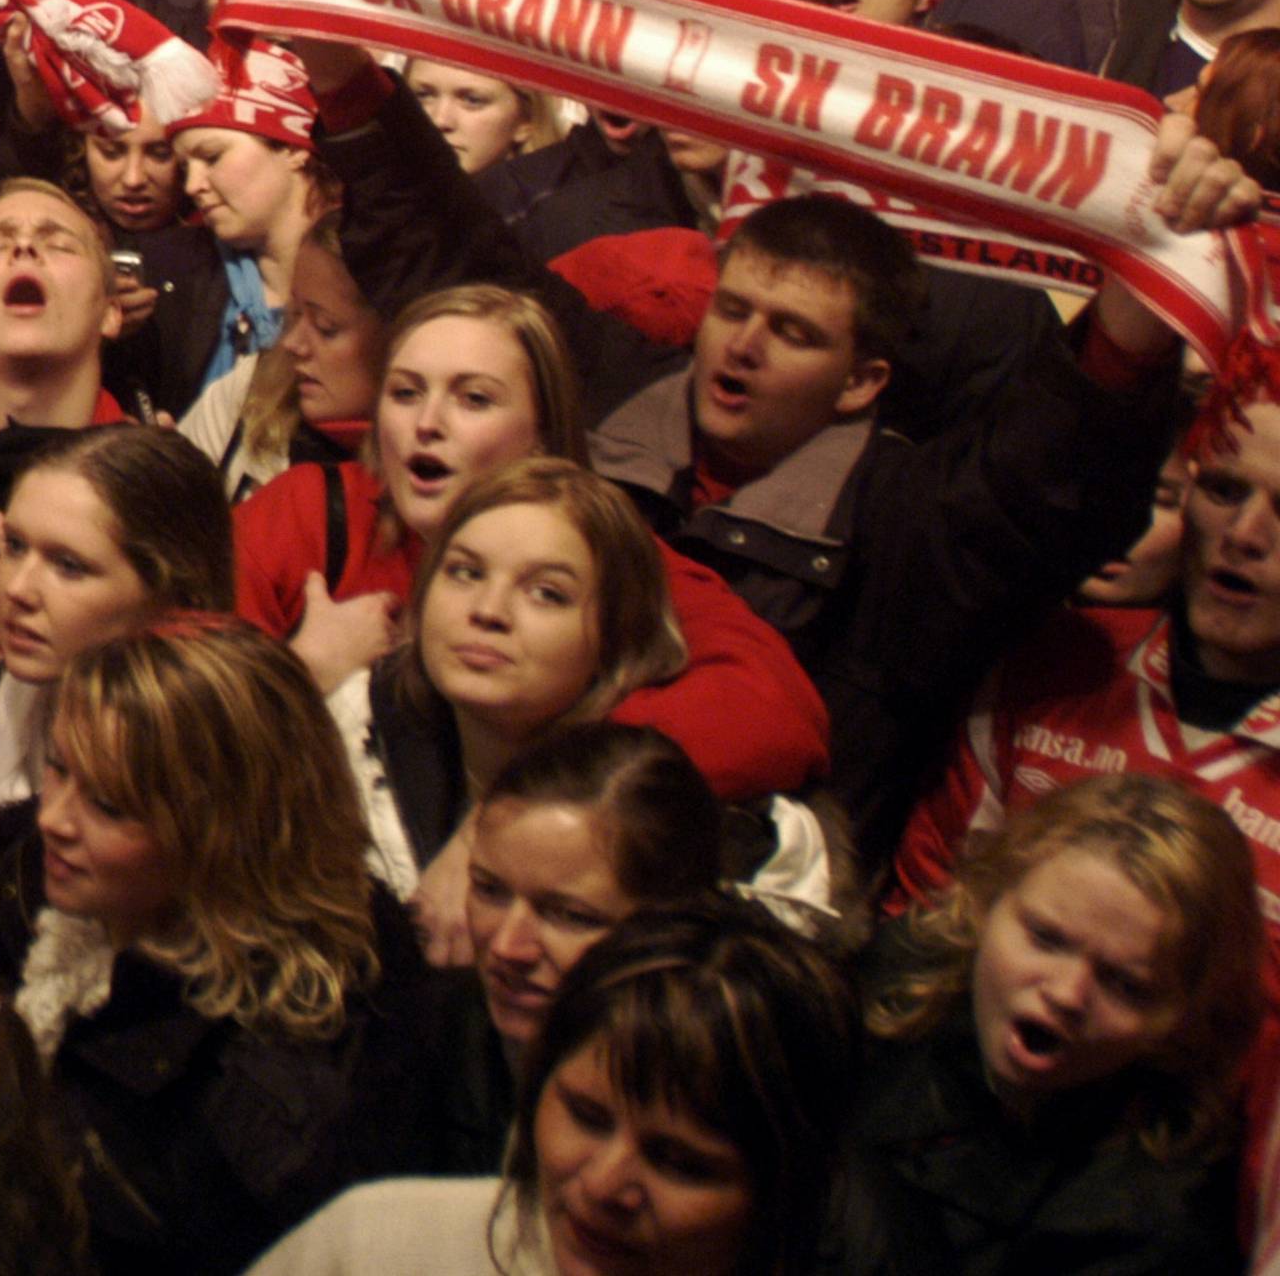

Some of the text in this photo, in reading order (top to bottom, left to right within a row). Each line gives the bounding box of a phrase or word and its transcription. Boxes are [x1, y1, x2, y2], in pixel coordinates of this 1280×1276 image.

[739, 42, 842, 131] SK
[853, 73, 1114, 211] BRANN
[917, 232, 1106, 287] STLAND
